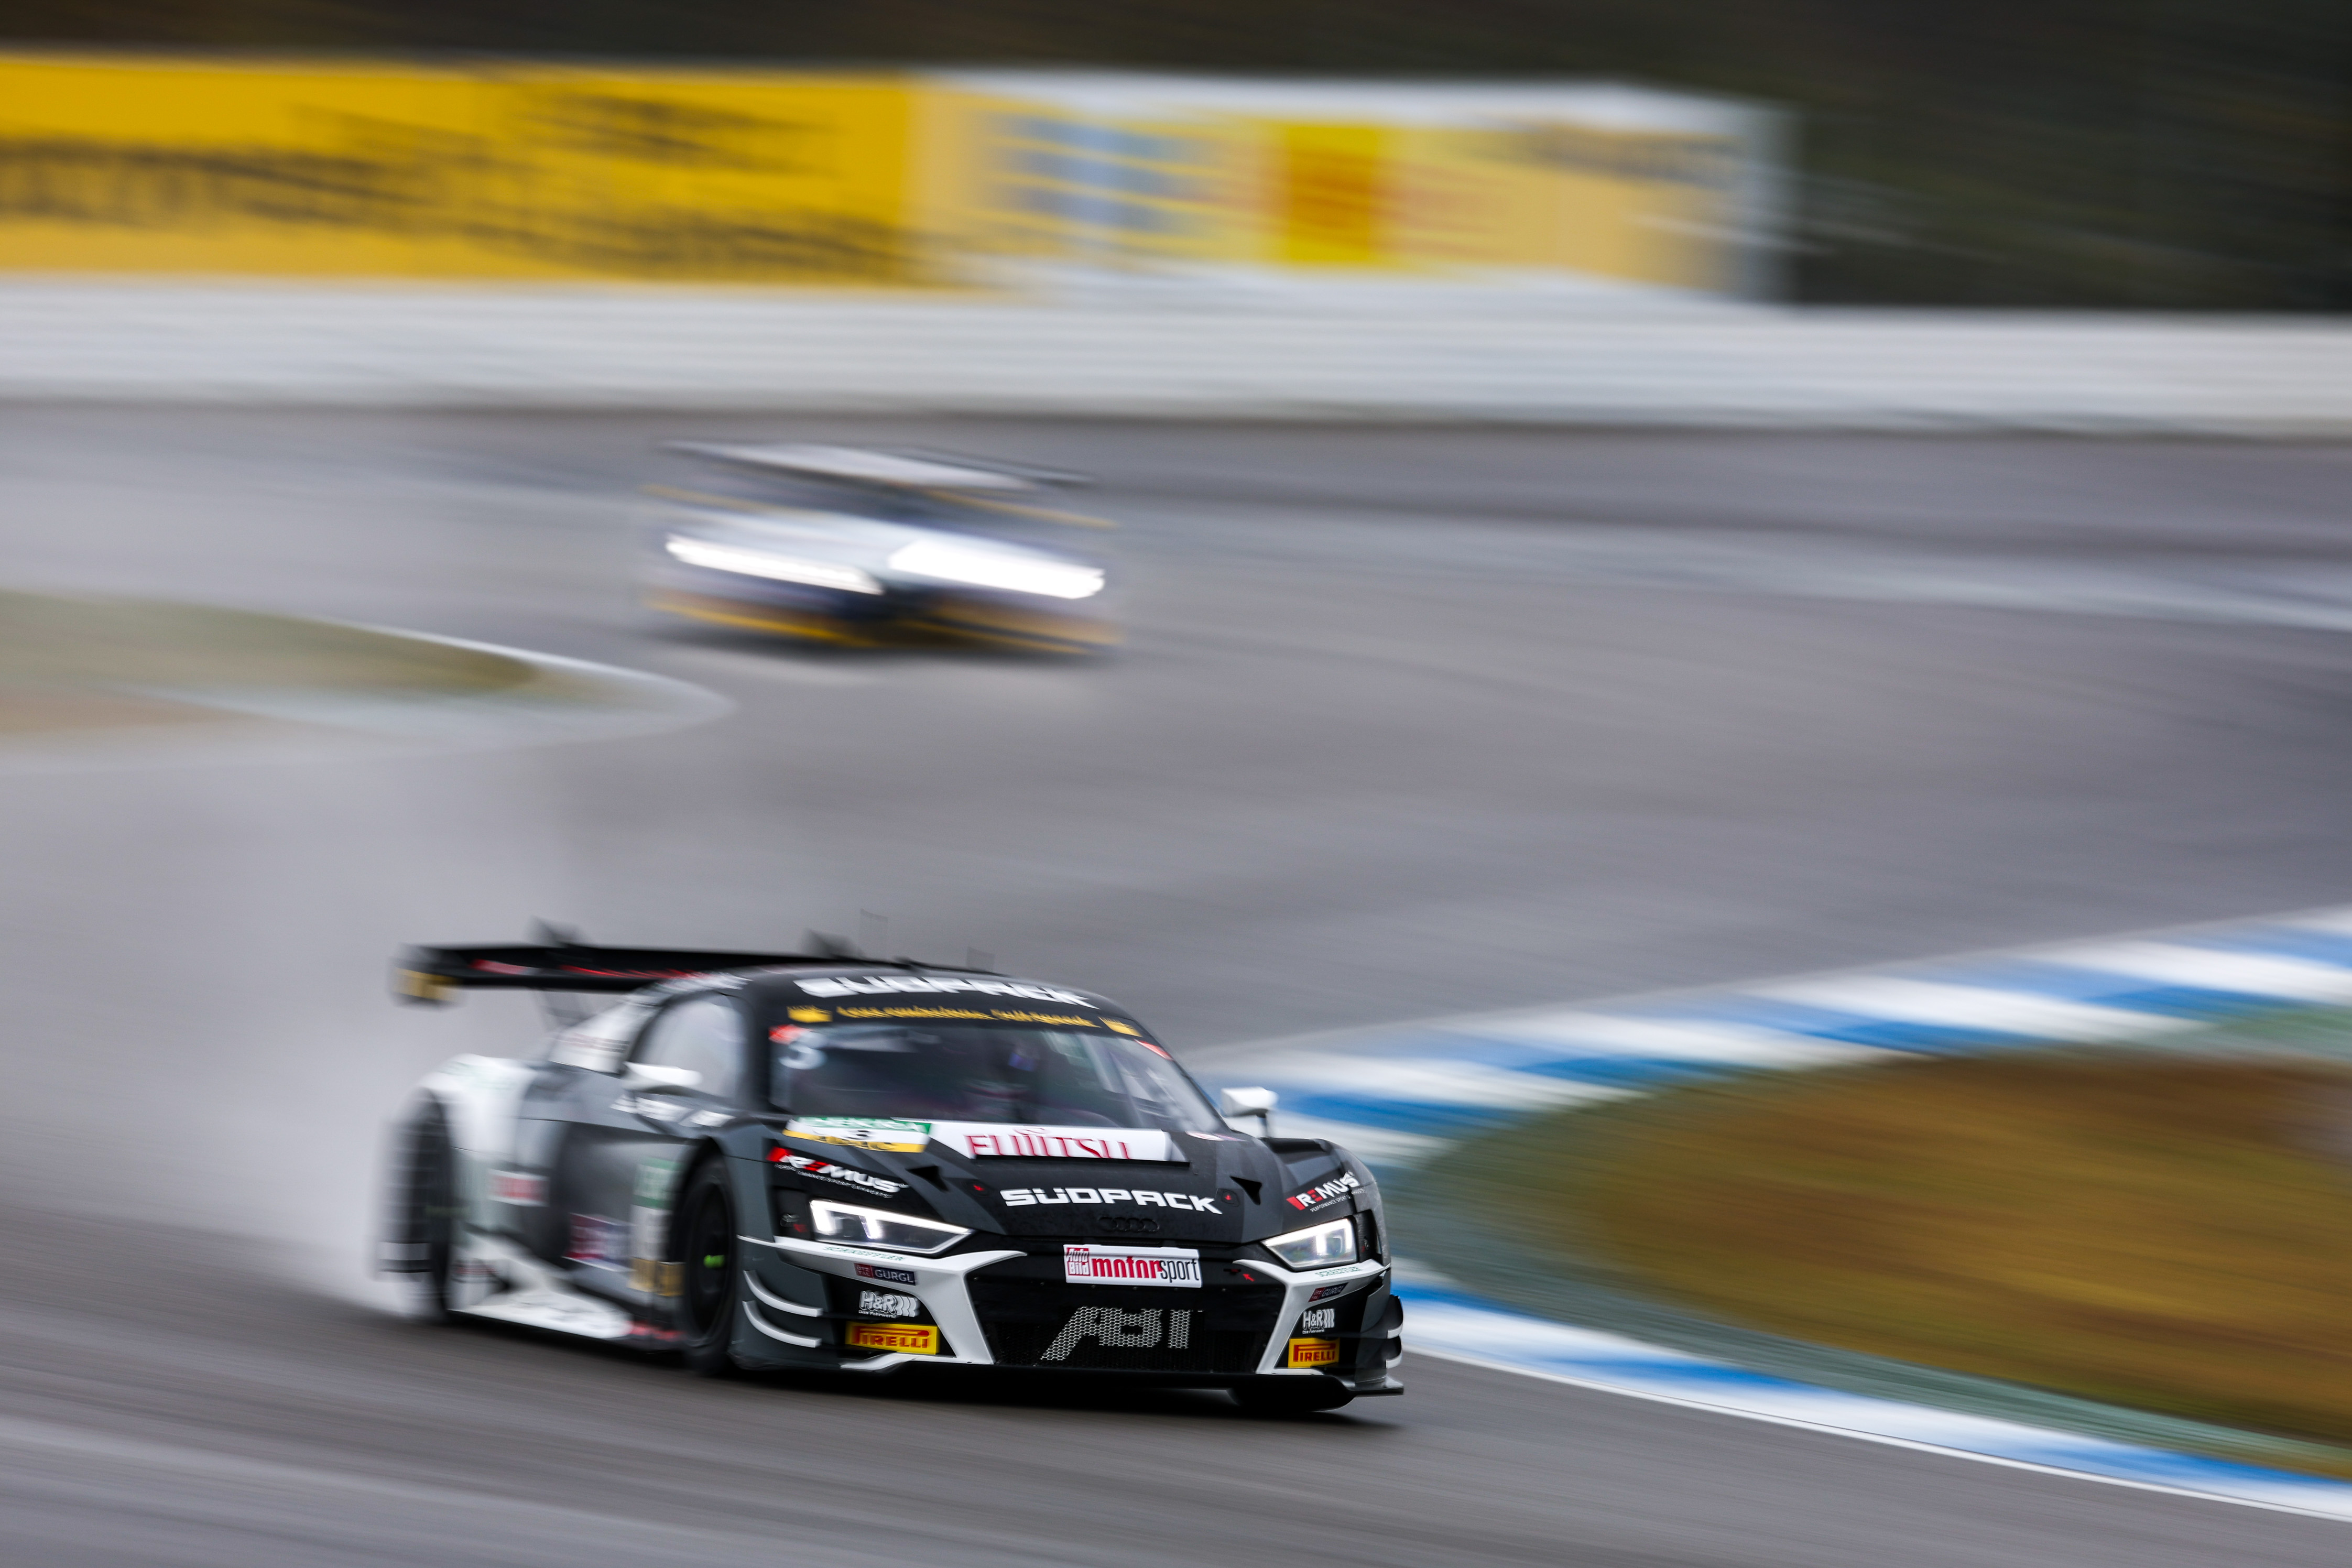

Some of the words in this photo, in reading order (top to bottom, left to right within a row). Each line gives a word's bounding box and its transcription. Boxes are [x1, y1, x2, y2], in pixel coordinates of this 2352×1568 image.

[1295, 1172, 1360, 1207] REMUS
[1066, 1248, 1088, 1262] Auto
[875, 1269, 913, 1283] GURGL
[1069, 1262, 1090, 1275] Bild
[1091, 1256, 1201, 1283] motorsport
[859, 1291, 896, 1315] H&R
[1302, 1310, 1324, 1330] H&R
[852, 1325, 929, 1349] PIRELLI
[1293, 1343, 1336, 1363] PIRELLI
